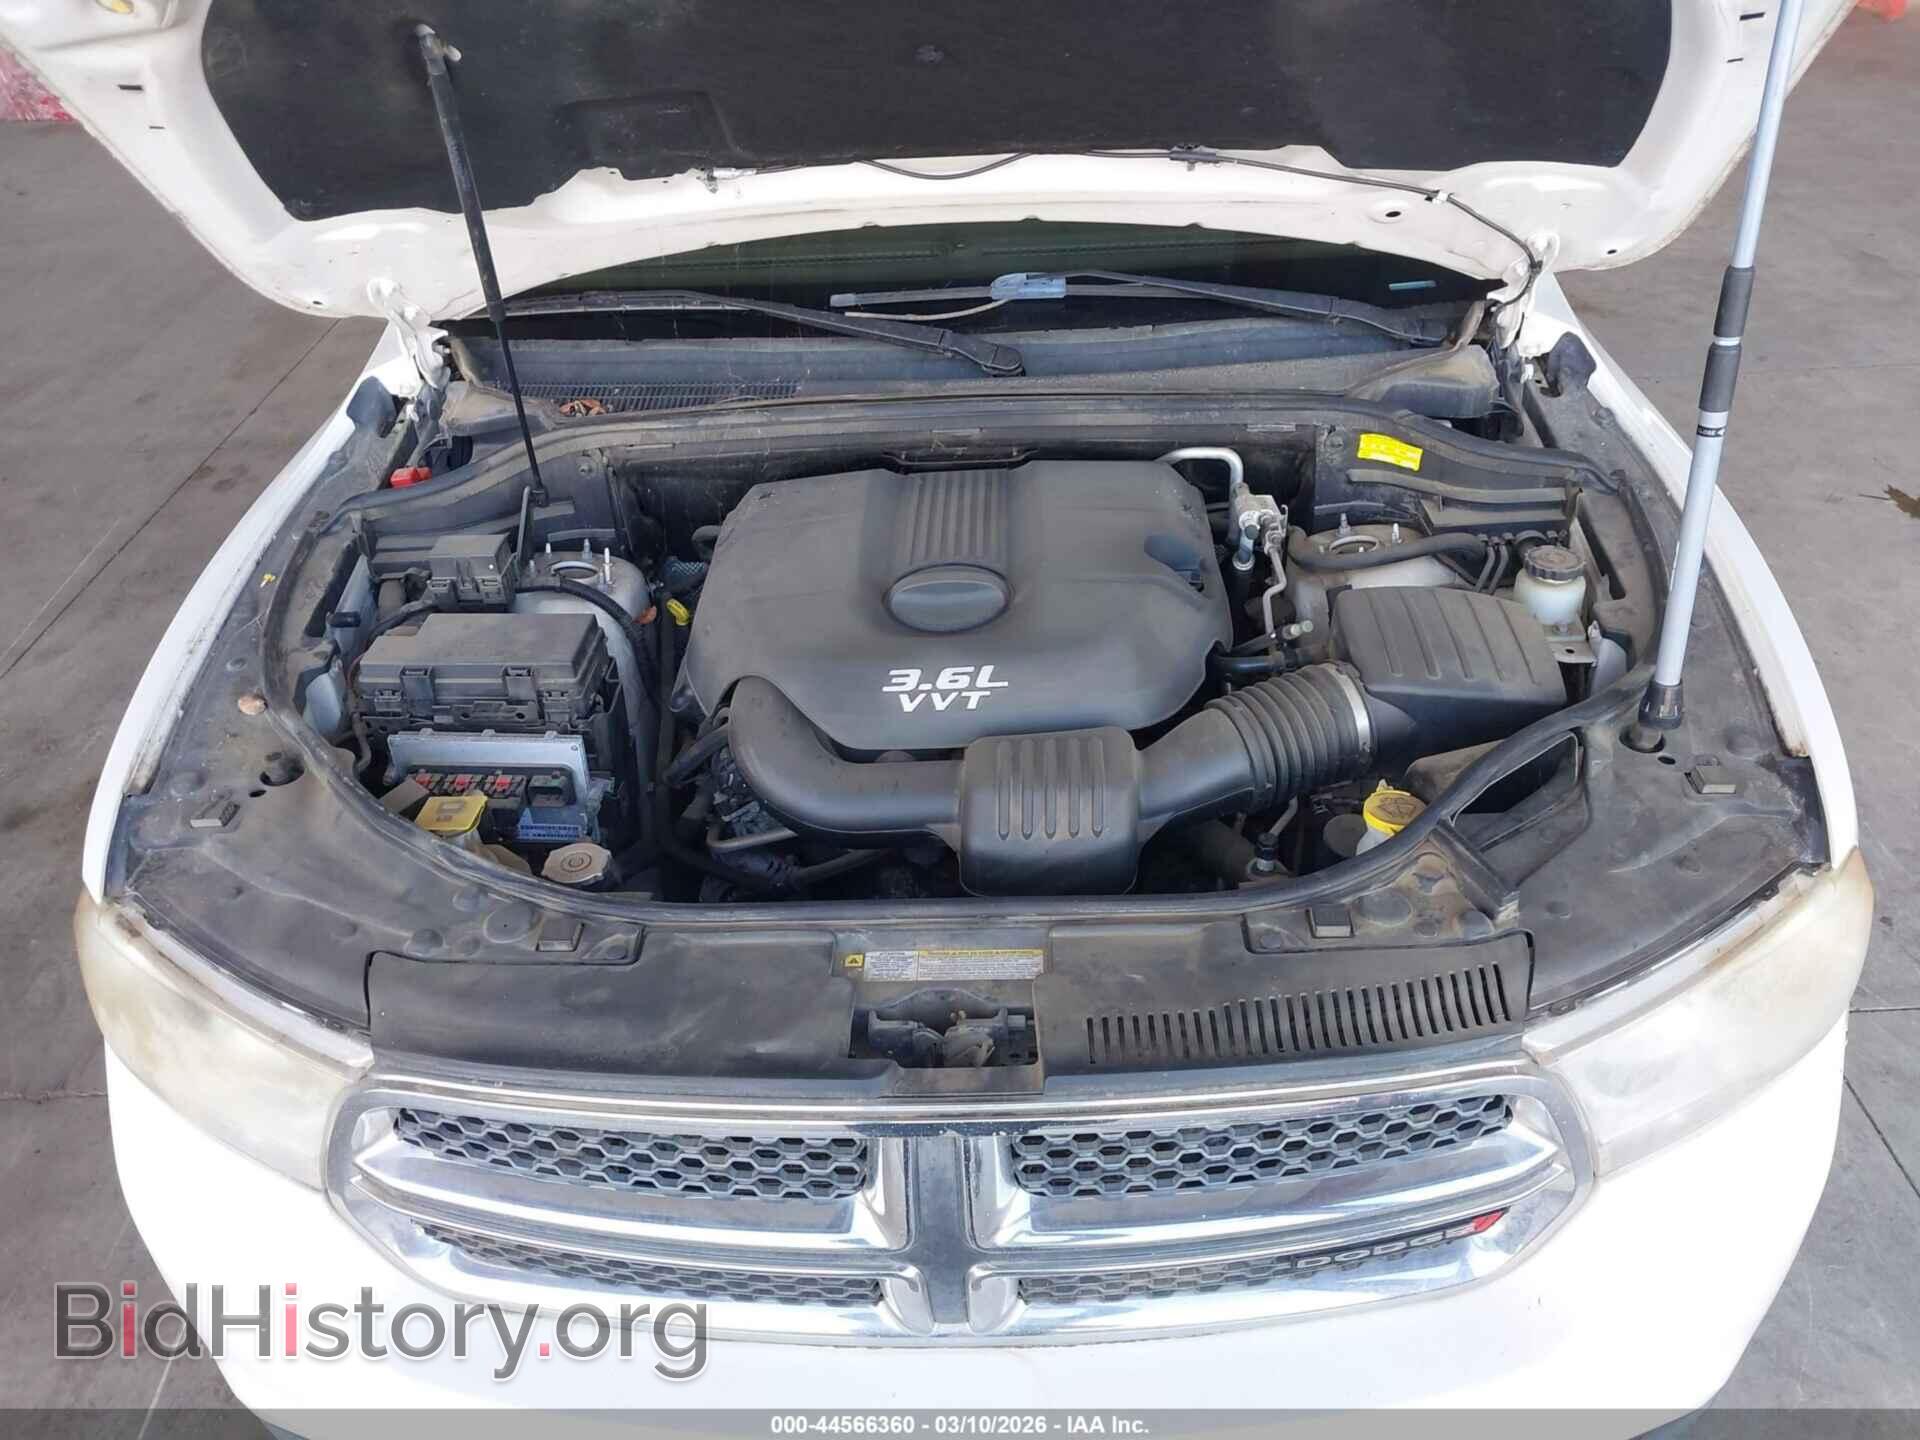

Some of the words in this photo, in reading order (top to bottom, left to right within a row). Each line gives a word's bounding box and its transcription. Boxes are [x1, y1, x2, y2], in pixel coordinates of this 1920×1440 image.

[882, 665, 1009, 692] 3.6L
[899, 691, 991, 712] VVT
[1297, 1224, 1473, 1268] DODGE
